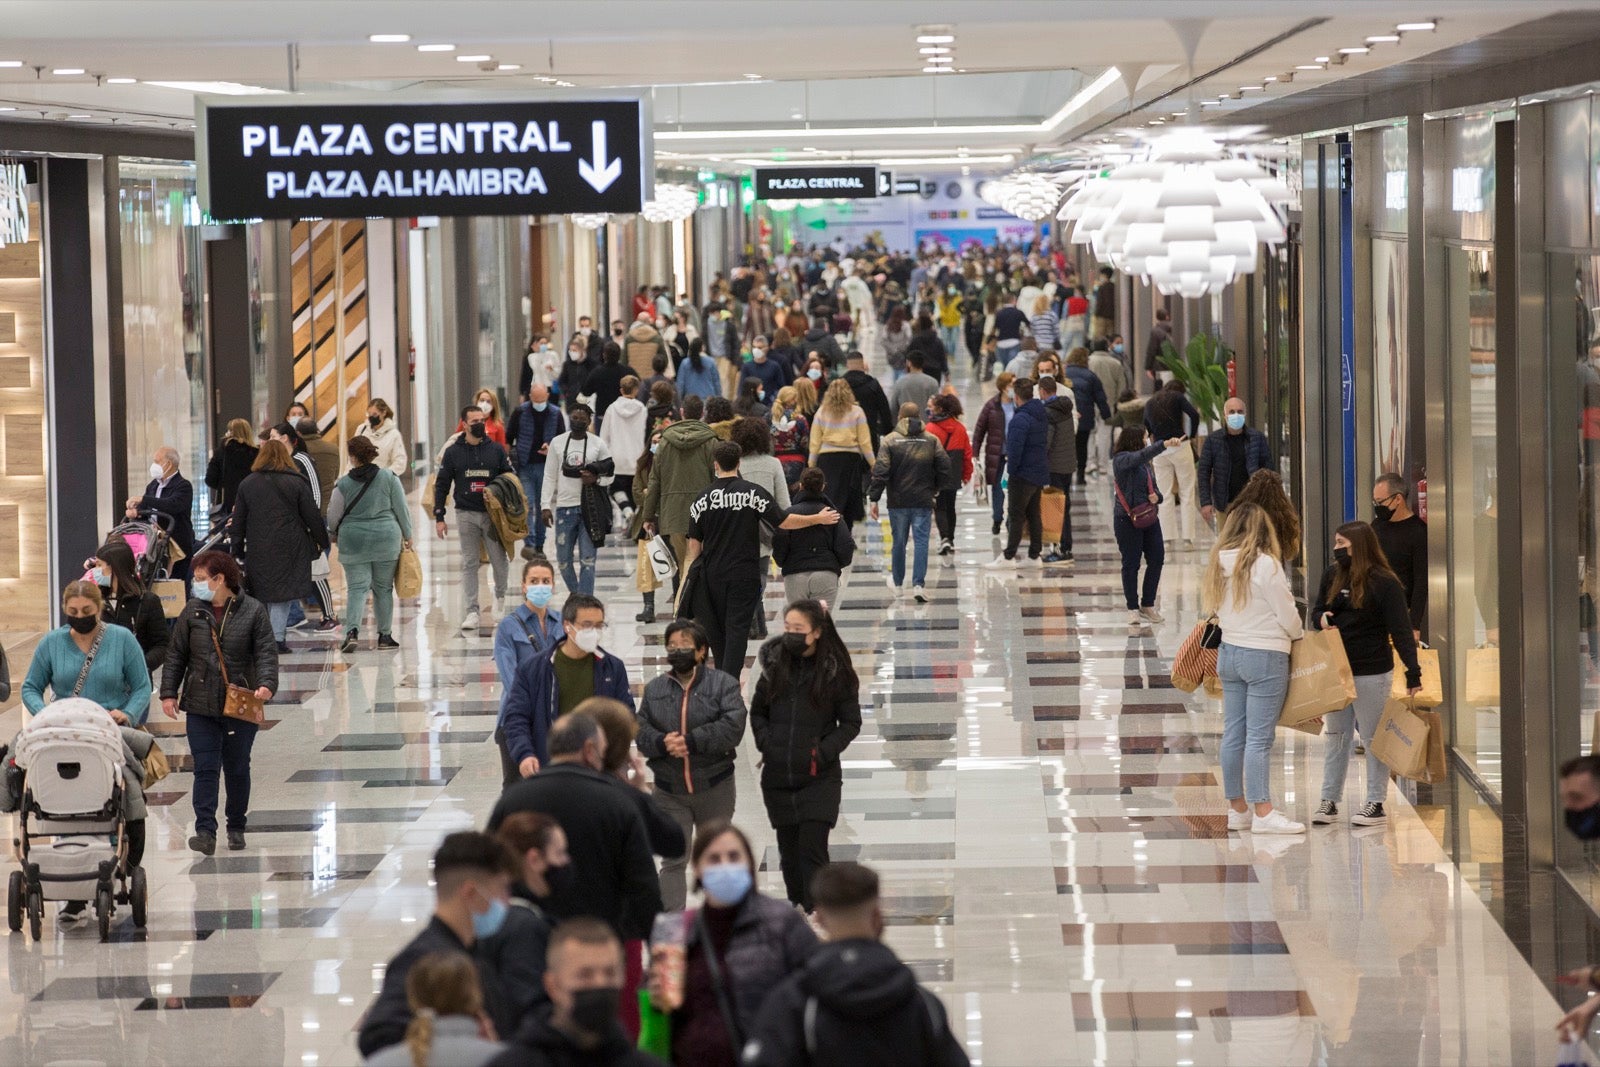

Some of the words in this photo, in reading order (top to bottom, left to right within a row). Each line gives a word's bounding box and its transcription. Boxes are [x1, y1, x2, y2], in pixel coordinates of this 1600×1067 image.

[242, 123, 374, 157] PLAZA
[384, 120, 572, 156] CENTRAL
[266, 170, 369, 199] PLAZA
[371, 166, 549, 198] ALHAMBRA
[768, 178, 808, 190] PLAZA
[808, 177, 865, 189] CENTRAL
[689, 493, 708, 524] Los
[709, 488, 770, 513] Angeles
[652, 549, 671, 575] S
